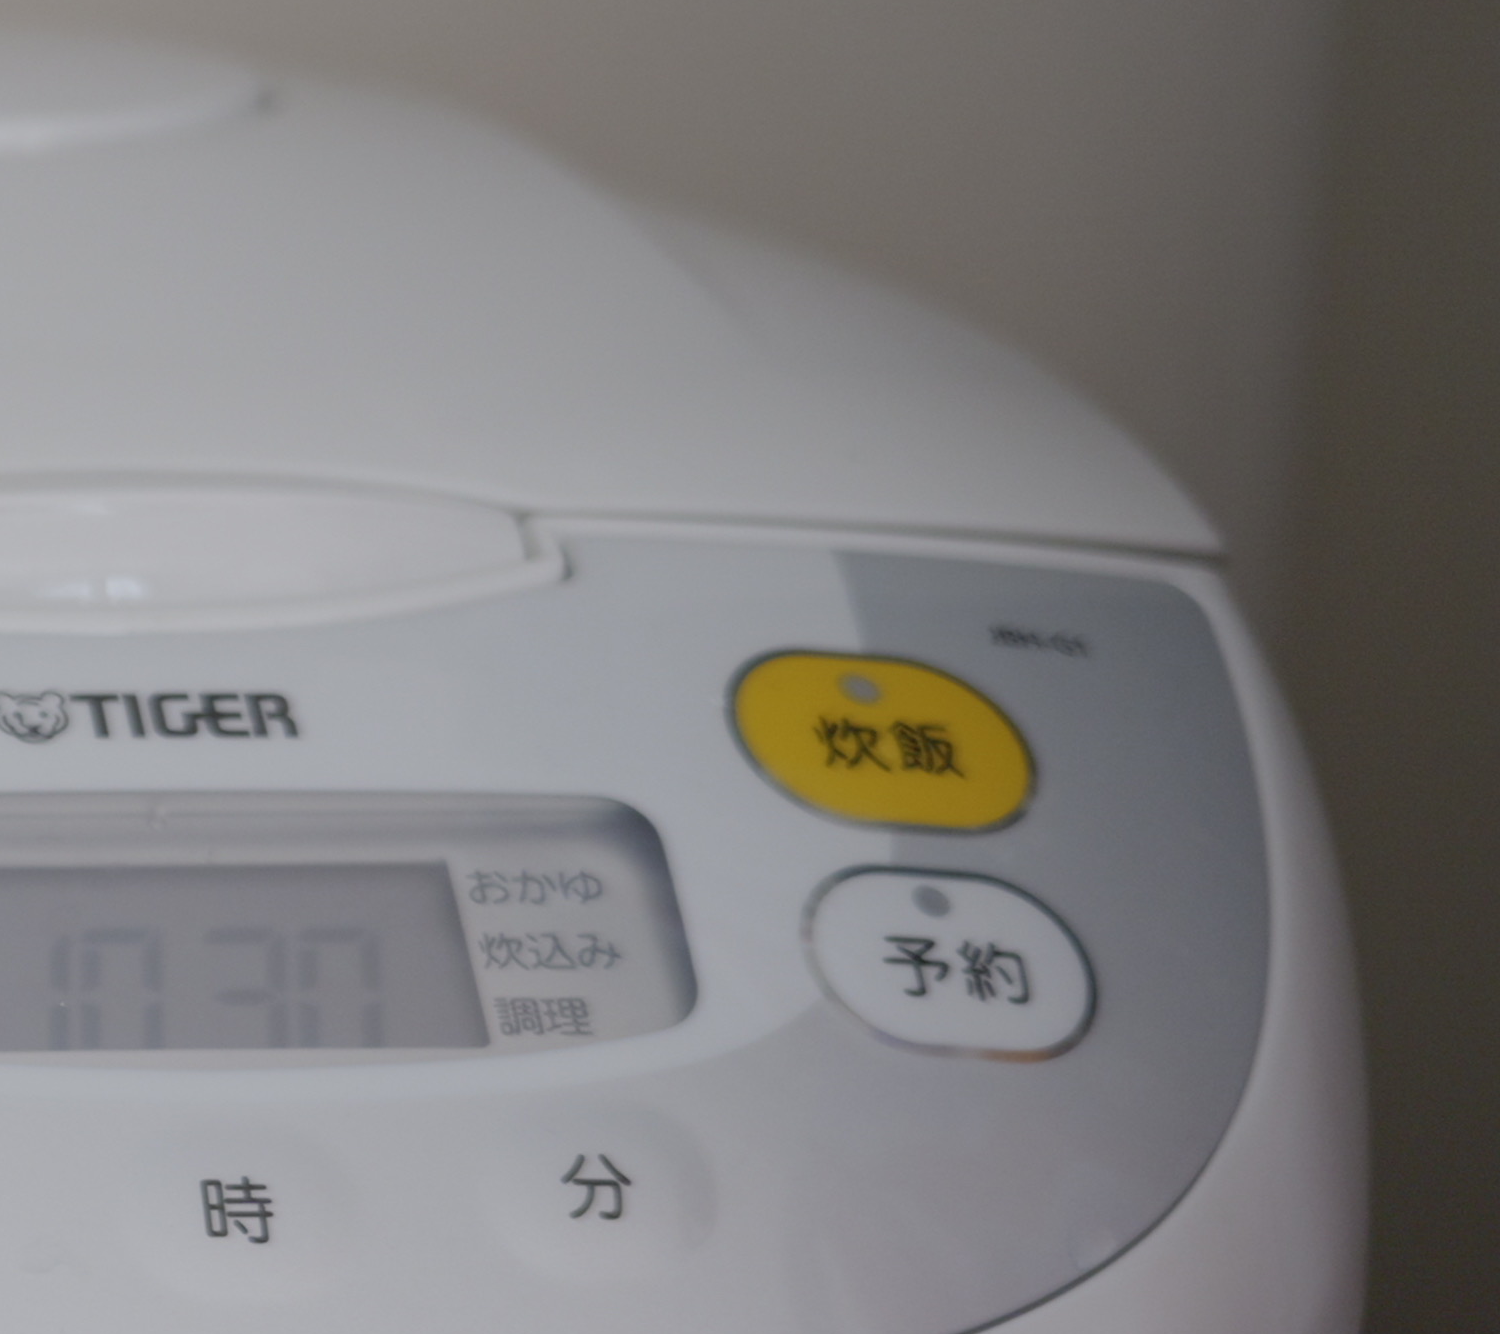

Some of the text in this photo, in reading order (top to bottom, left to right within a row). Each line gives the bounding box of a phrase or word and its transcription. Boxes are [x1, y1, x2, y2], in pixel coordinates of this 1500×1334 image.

[72, 691, 300, 739] TIGER
[816, 717, 966, 779] 炊飯
[468, 868, 607, 907] おかゆ
[480, 931, 624, 971] 炊込み
[880, 933, 1032, 1007] 予約
[496, 996, 594, 1037] 調理
[199, 1175, 275, 1246] 時
[561, 1153, 634, 1222] 分
